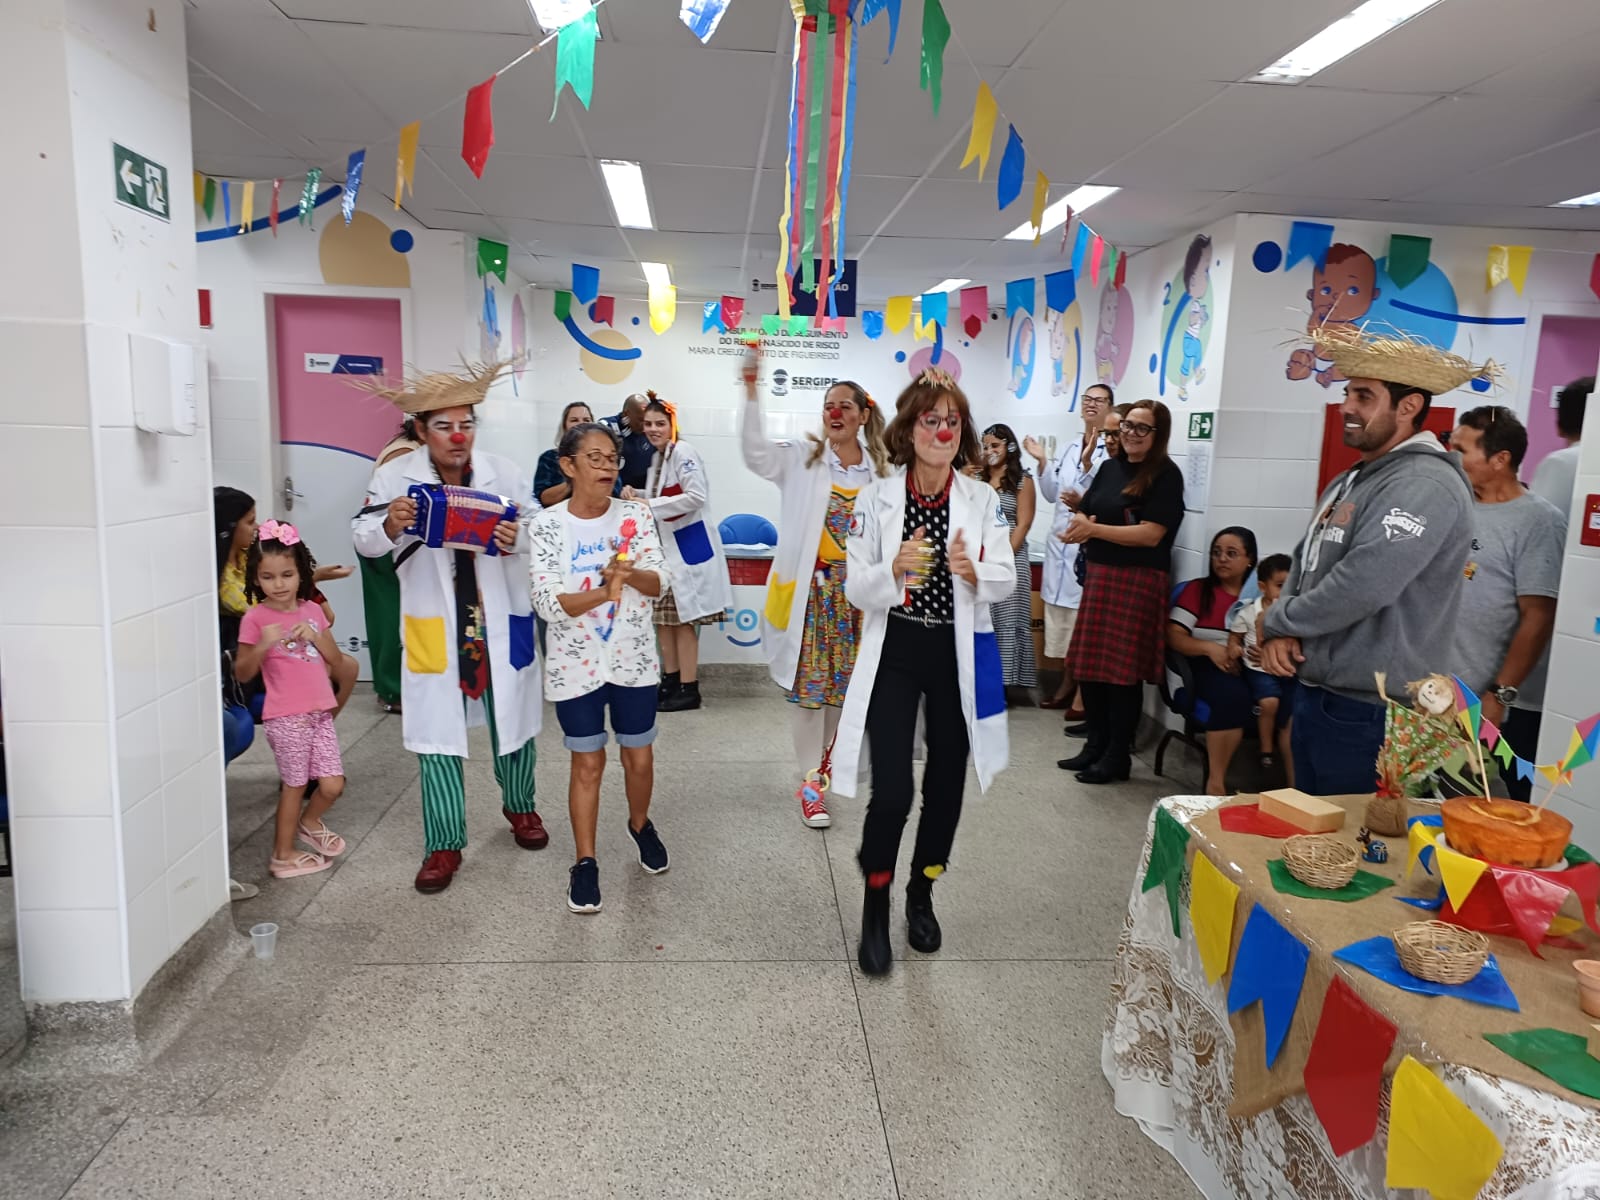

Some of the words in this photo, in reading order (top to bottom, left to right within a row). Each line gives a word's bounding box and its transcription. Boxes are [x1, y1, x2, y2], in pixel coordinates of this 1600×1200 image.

[802, 340, 814, 349] DE
[815, 341, 840, 350] RISCO
[688, 346, 715, 355] MARIA
